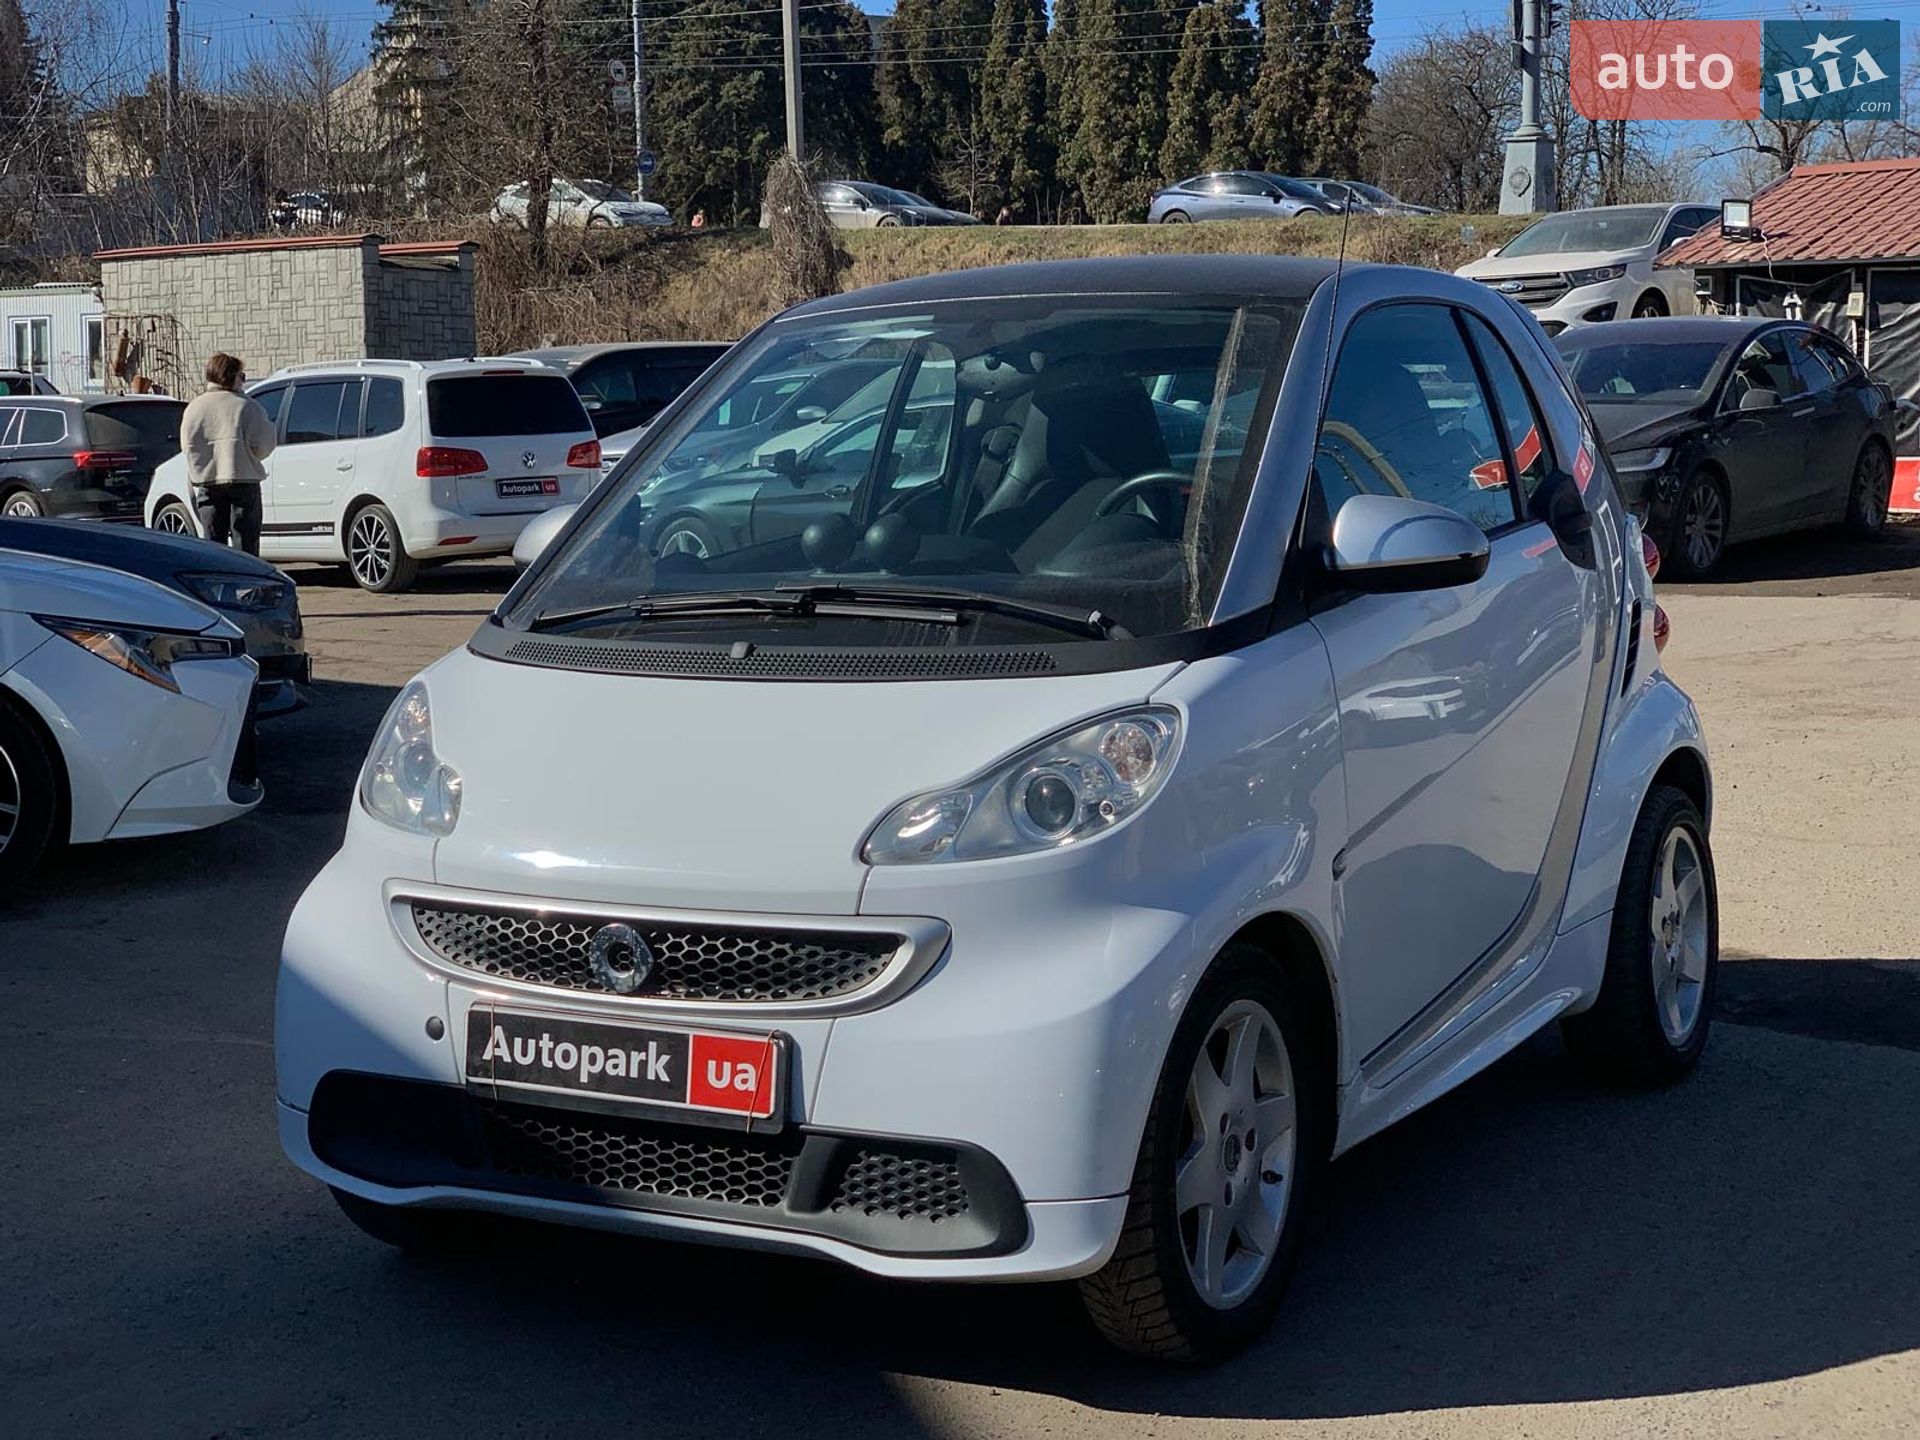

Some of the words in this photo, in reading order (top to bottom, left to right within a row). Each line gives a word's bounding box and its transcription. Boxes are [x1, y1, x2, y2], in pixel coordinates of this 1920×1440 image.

[502, 483, 541, 494] Autopark
[482, 1025, 671, 1083] Autopark
[706, 1059, 757, 1093] ua
